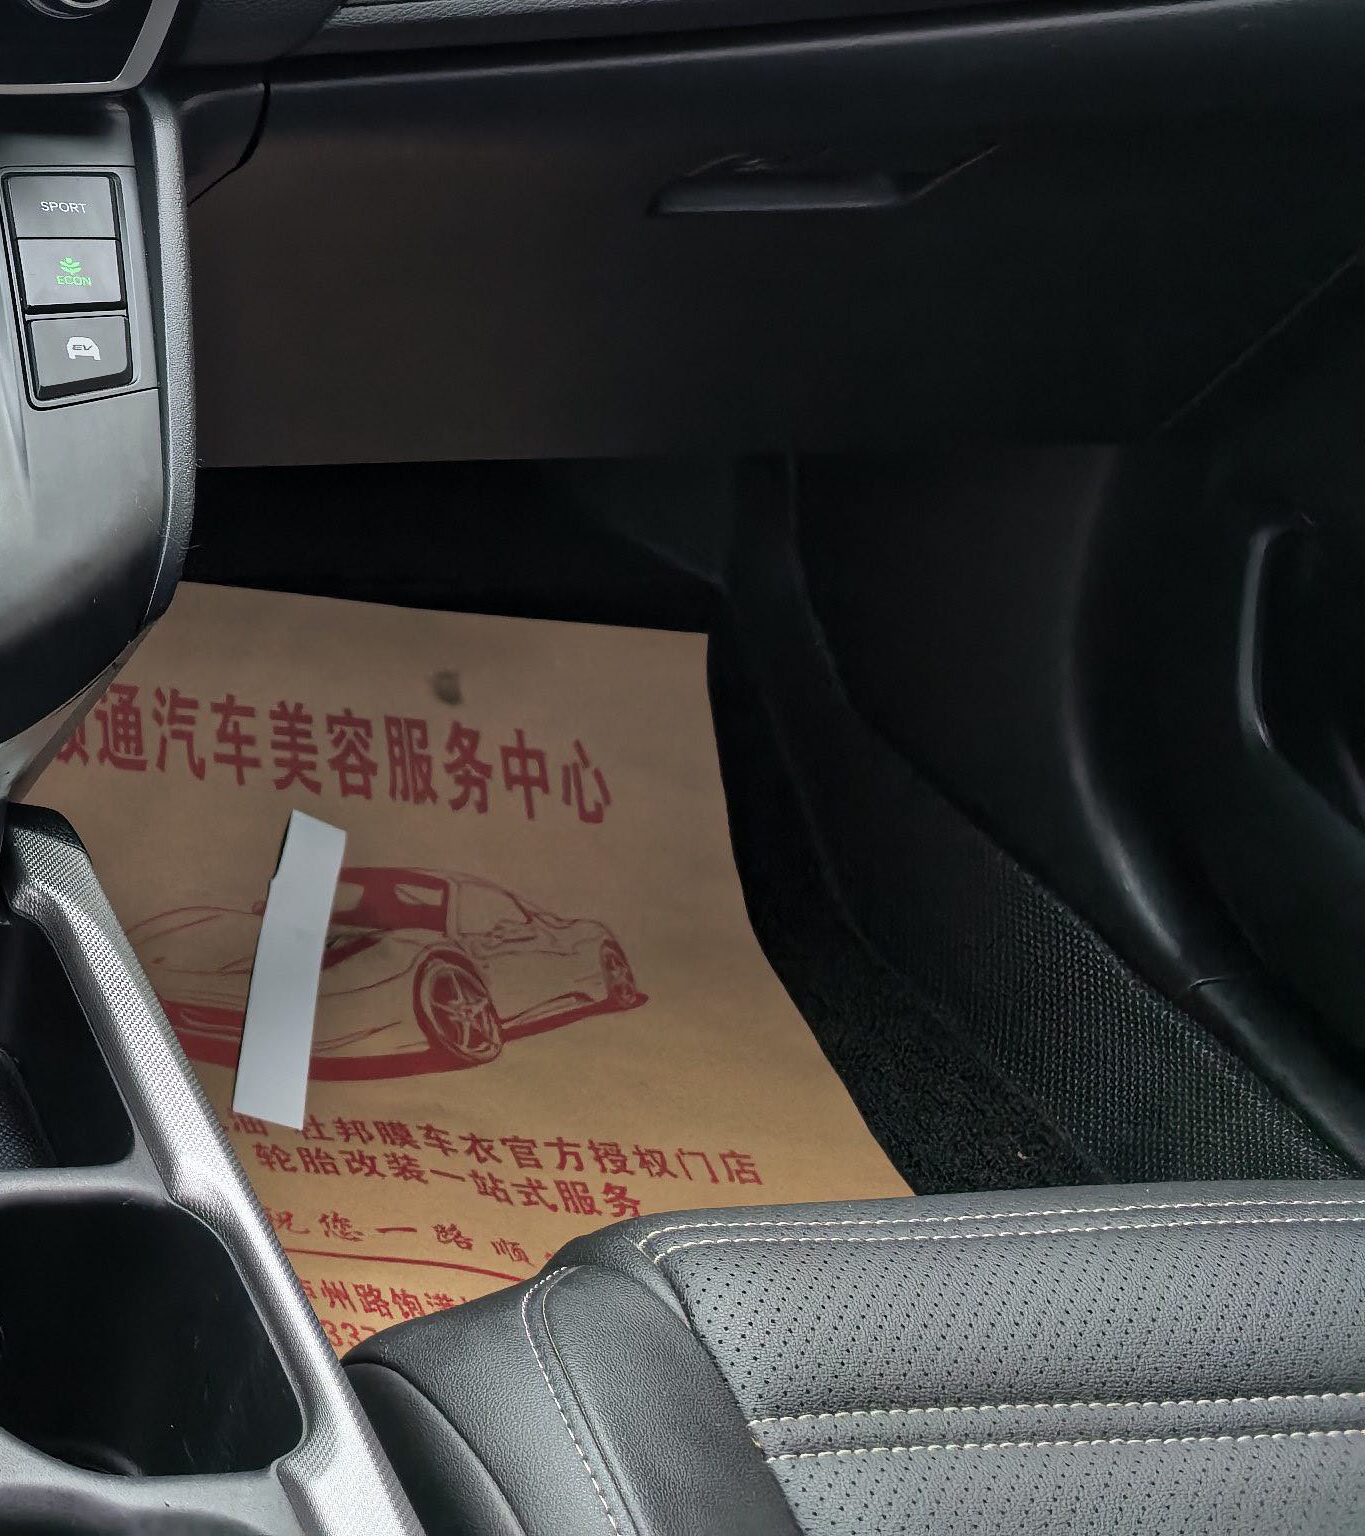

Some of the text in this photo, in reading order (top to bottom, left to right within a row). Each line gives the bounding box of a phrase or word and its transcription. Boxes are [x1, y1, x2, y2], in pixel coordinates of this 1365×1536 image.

[40, 201, 87, 214] SPORT
[56, 276, 92, 287] ECON
[252, 1141, 640, 1218] 轮胎改装一站式服务
